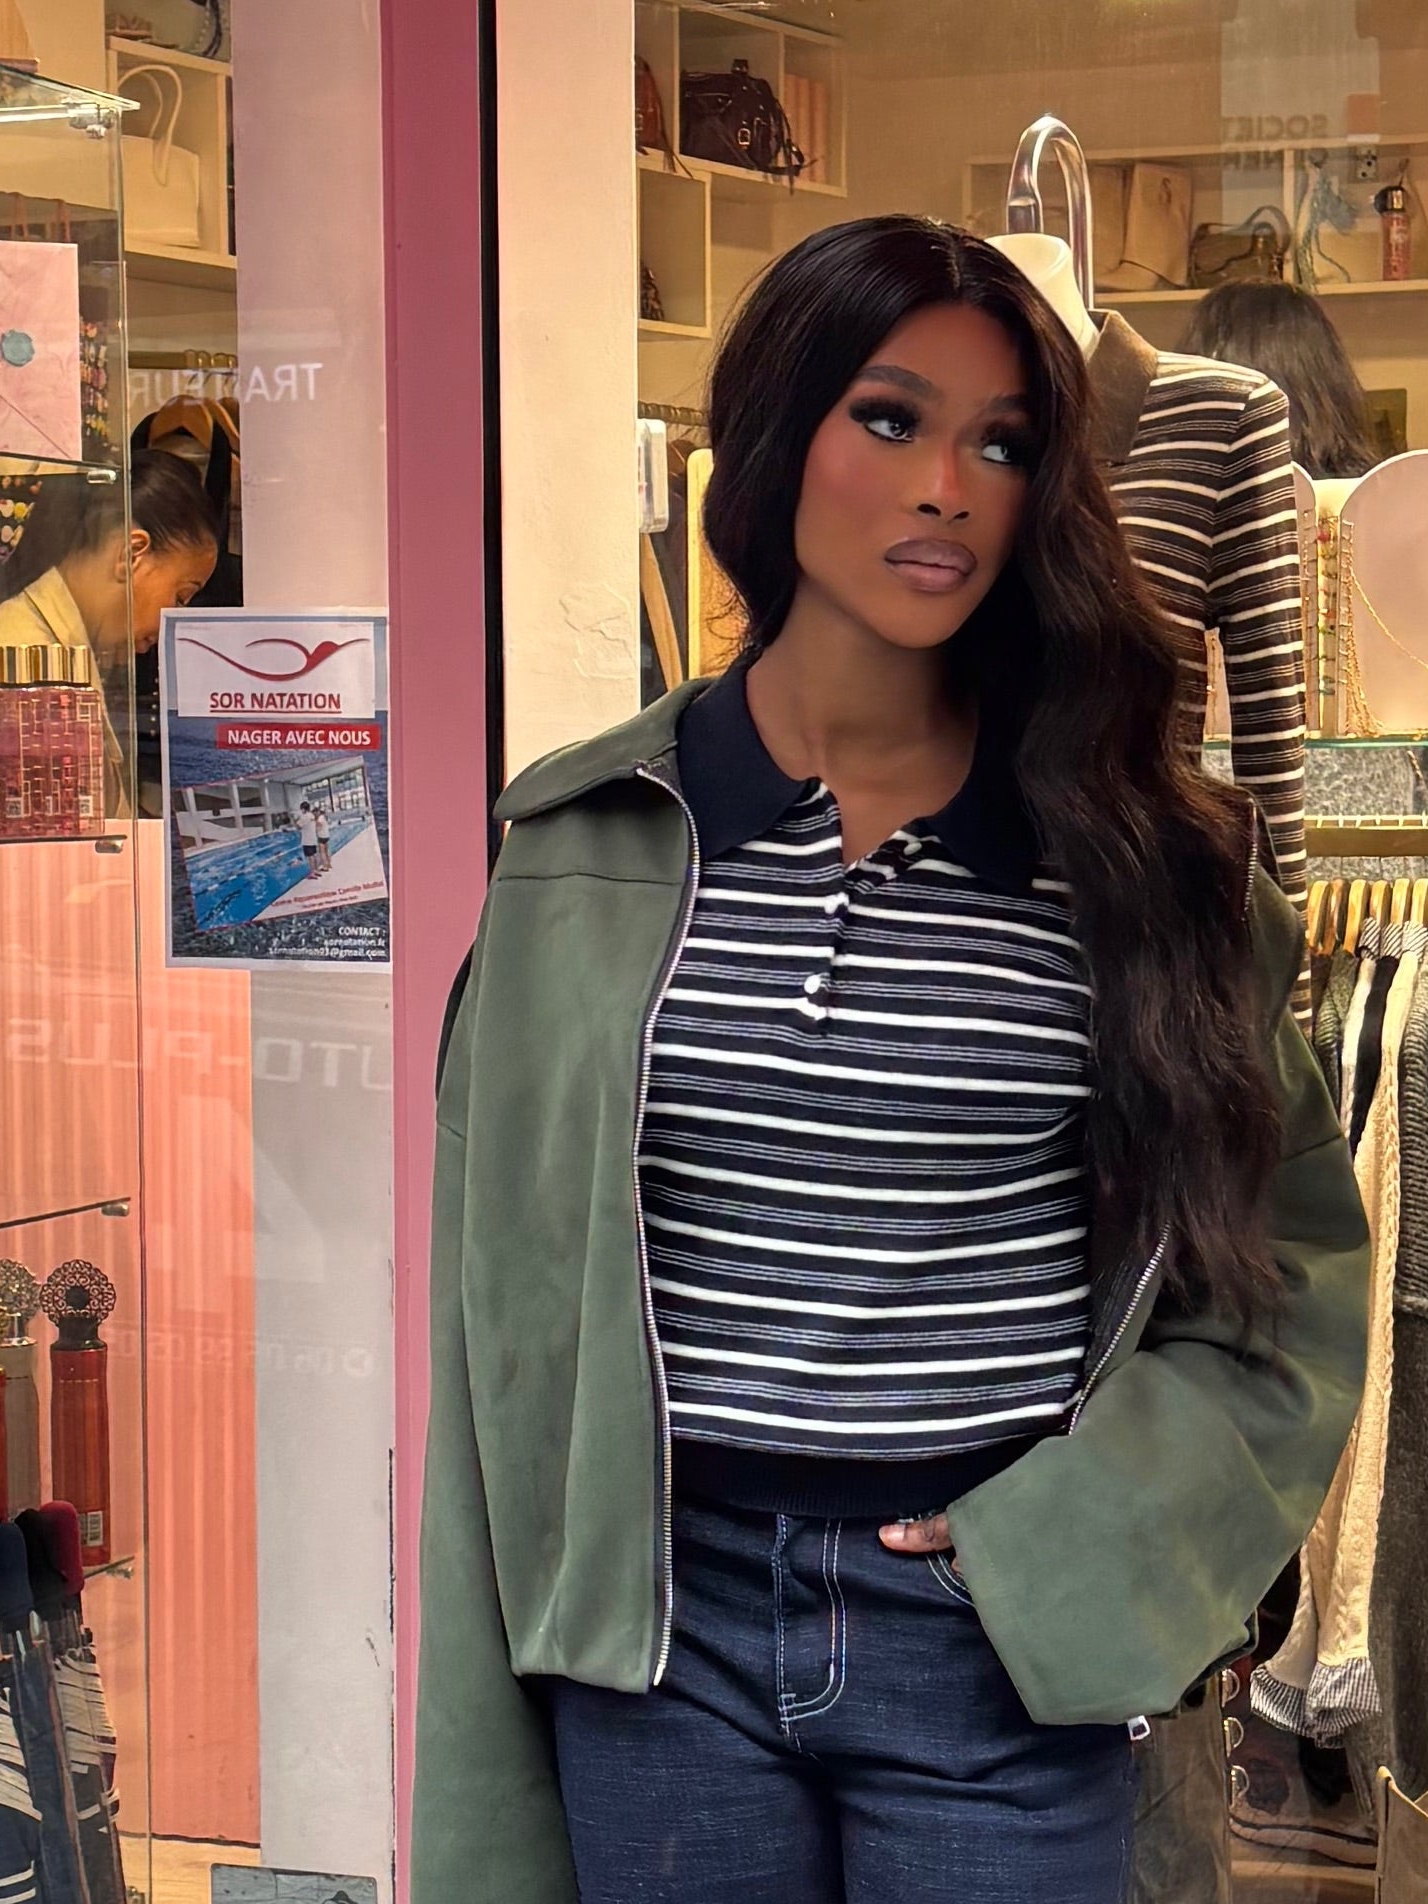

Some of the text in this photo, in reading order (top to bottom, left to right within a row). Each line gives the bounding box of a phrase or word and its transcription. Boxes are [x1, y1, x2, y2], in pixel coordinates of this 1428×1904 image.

[209, 691, 341, 710] SOR NATATION
[227, 728, 372, 747] NAGER AVEC NOUS
[338, 927, 381, 937] CONTACT
